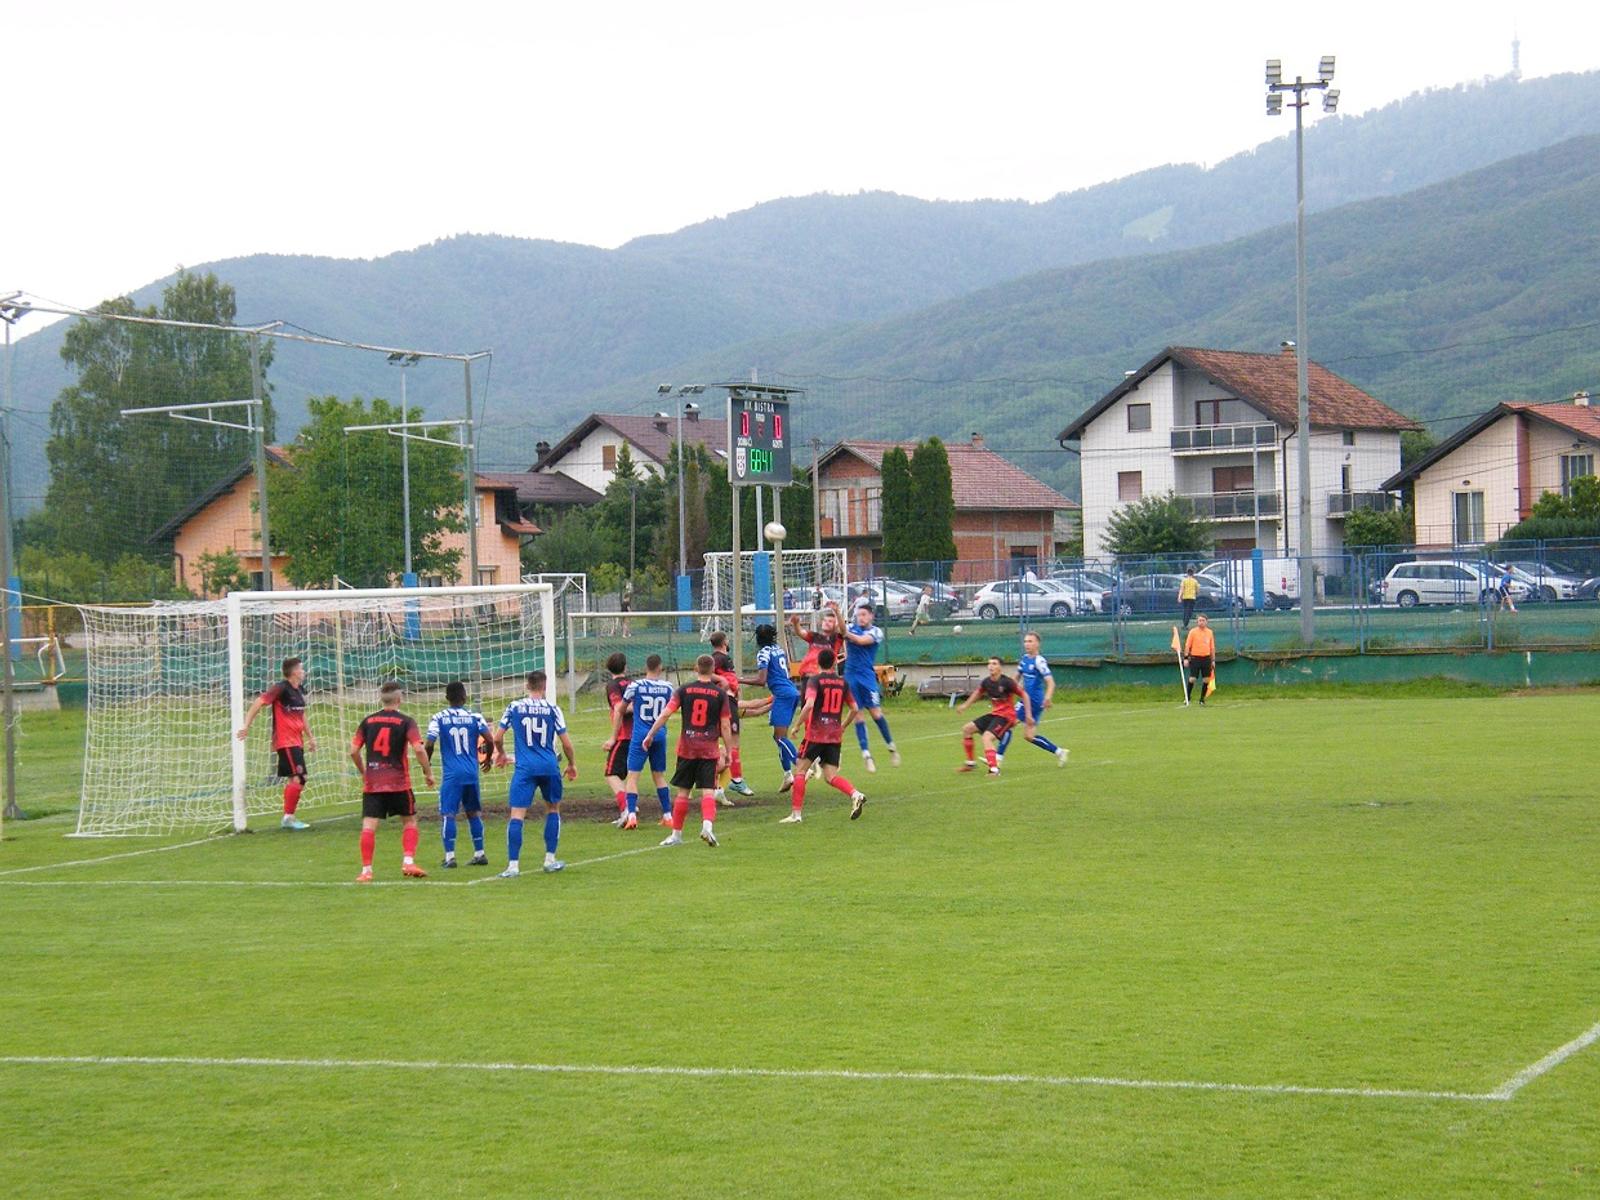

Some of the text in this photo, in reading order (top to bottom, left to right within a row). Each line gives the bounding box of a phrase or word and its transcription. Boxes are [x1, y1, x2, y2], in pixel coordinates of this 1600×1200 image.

[754, 401, 774, 412] BISTRA
[774, 415, 783, 439] 0
[778, 656, 789, 679] 9
[648, 686, 668, 694] BISTRA
[821, 688, 843, 713] 10
[528, 706, 551, 716] BISTRA
[640, 695, 667, 721] 20
[691, 698, 708, 727] 8
[372, 727, 391, 757] 4
[449, 727, 470, 755] 11
[521, 716, 548, 748] 14
